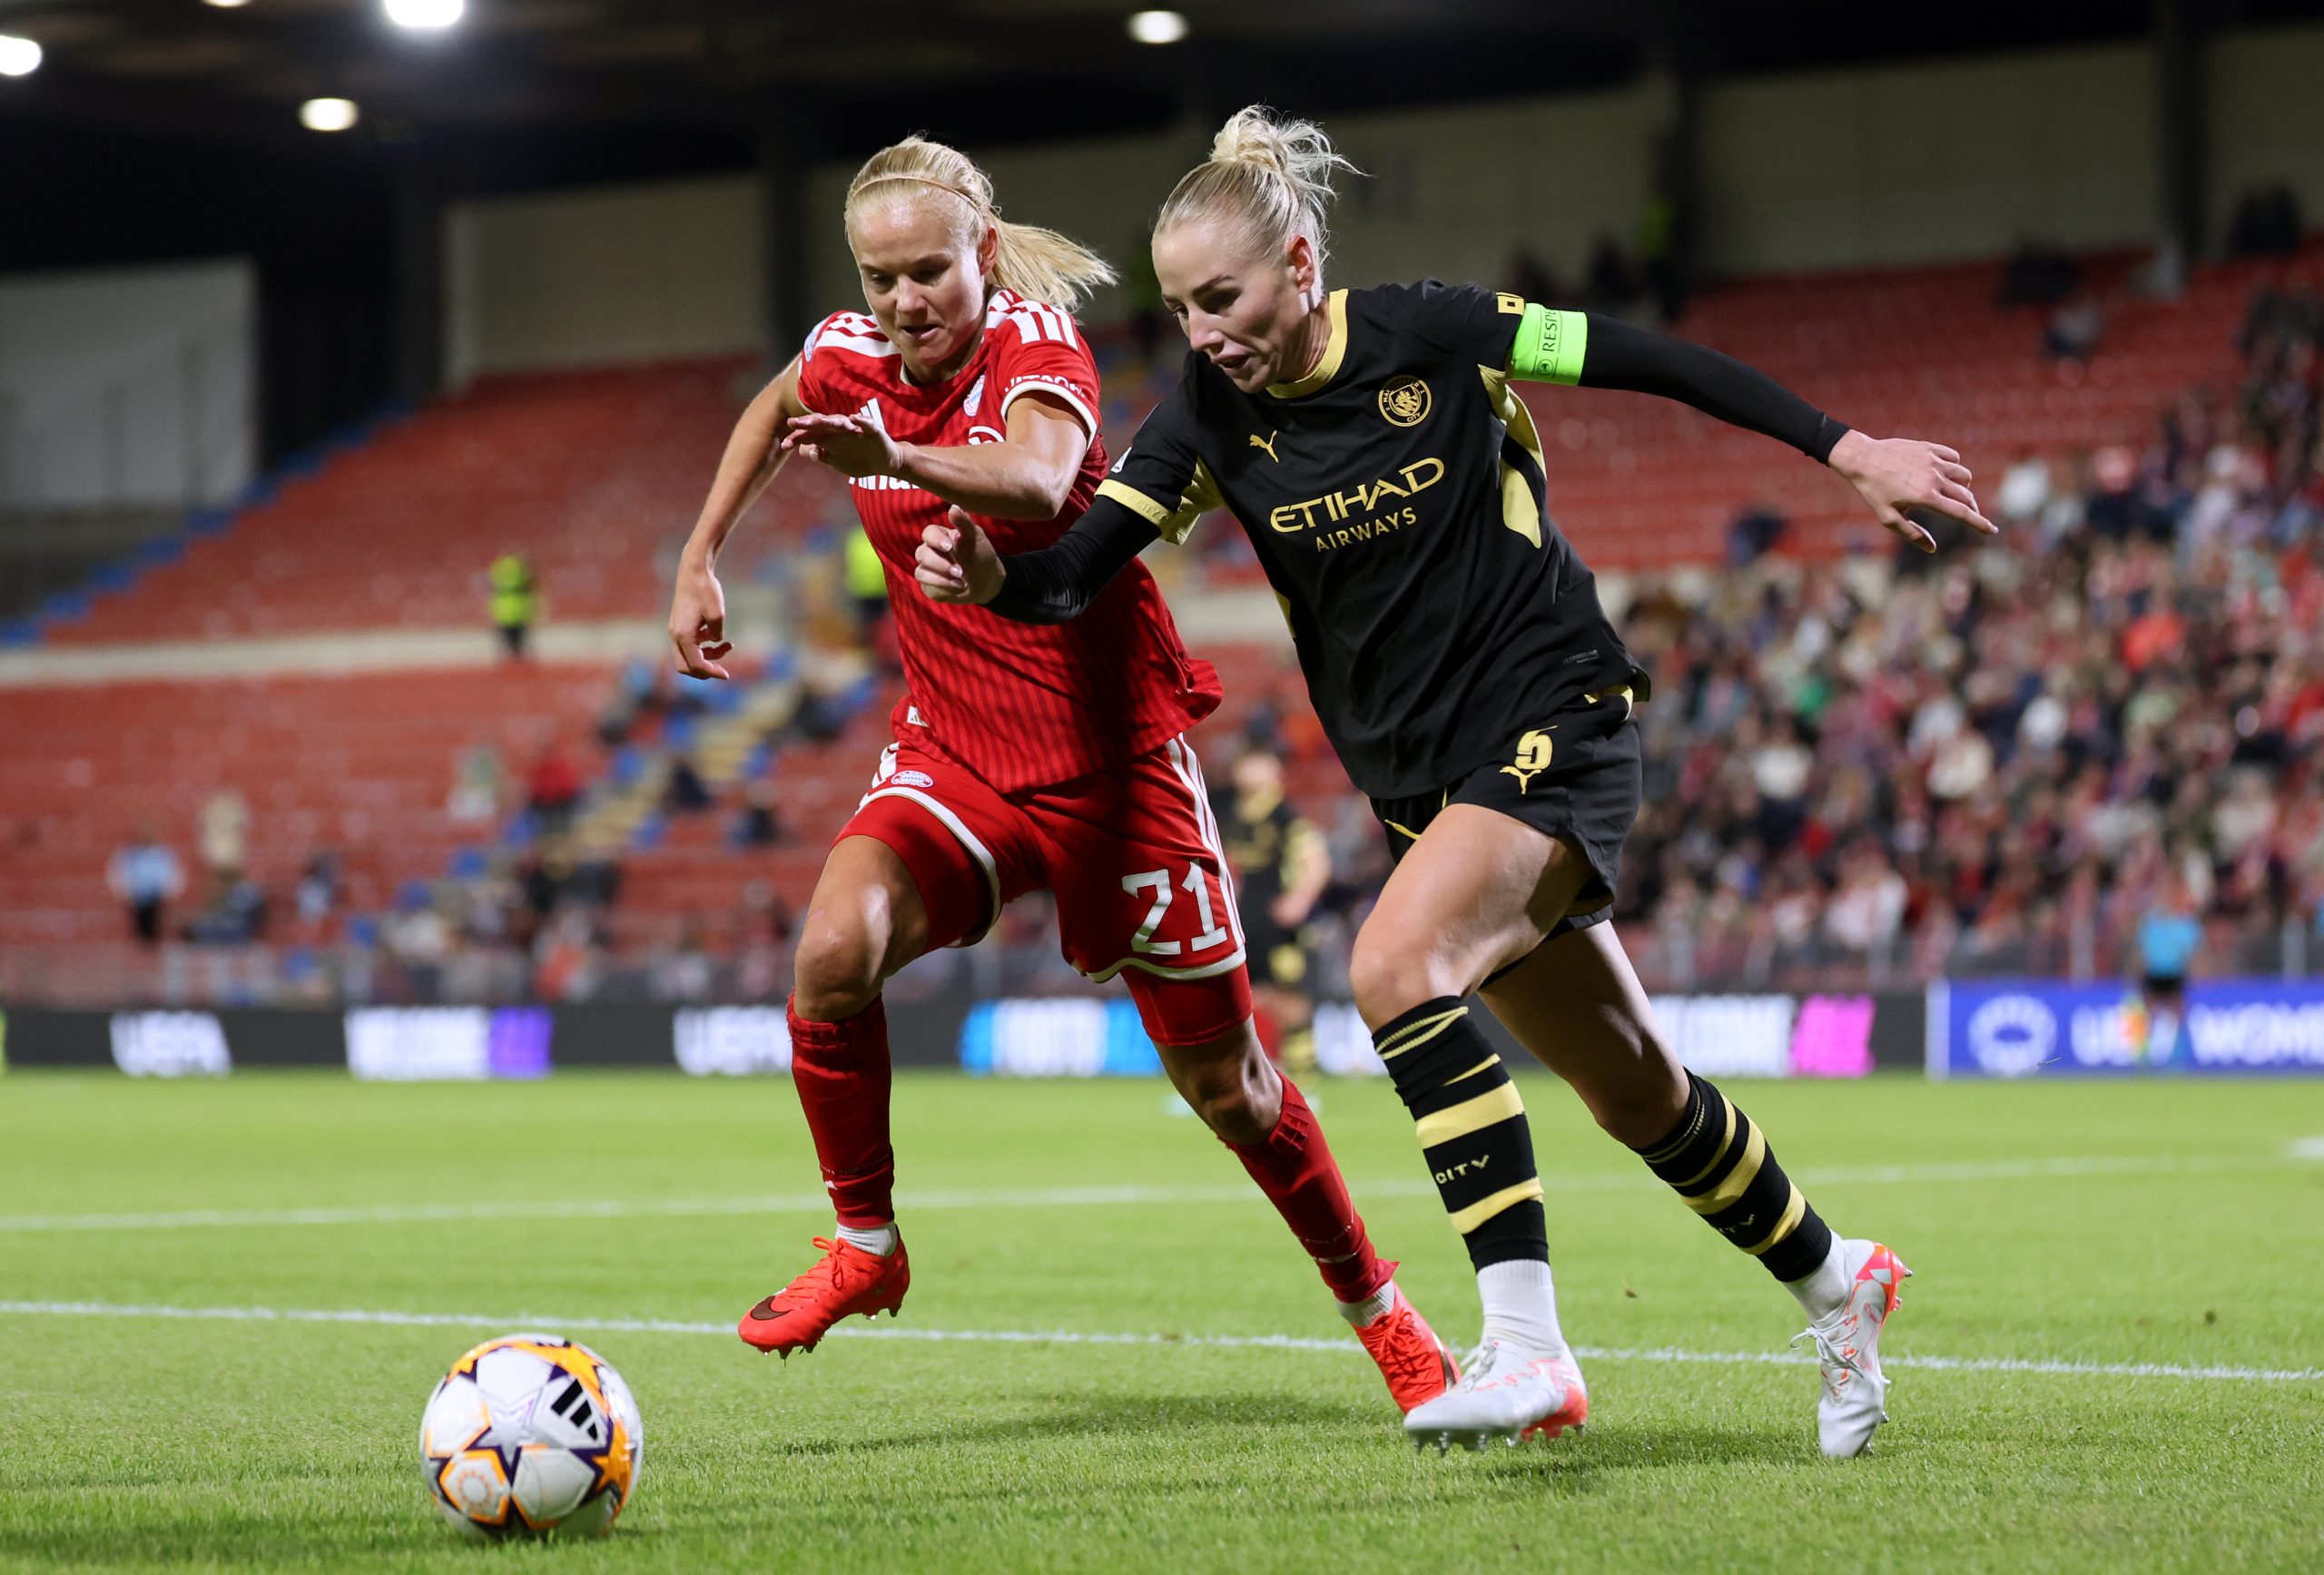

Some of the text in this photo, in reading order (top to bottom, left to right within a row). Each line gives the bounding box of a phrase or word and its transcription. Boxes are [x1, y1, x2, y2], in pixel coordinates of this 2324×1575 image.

[1270, 457, 1444, 533] ETIHAD
[1316, 507, 1417, 553] AIRWAYS
[1121, 858, 1228, 955] 21
